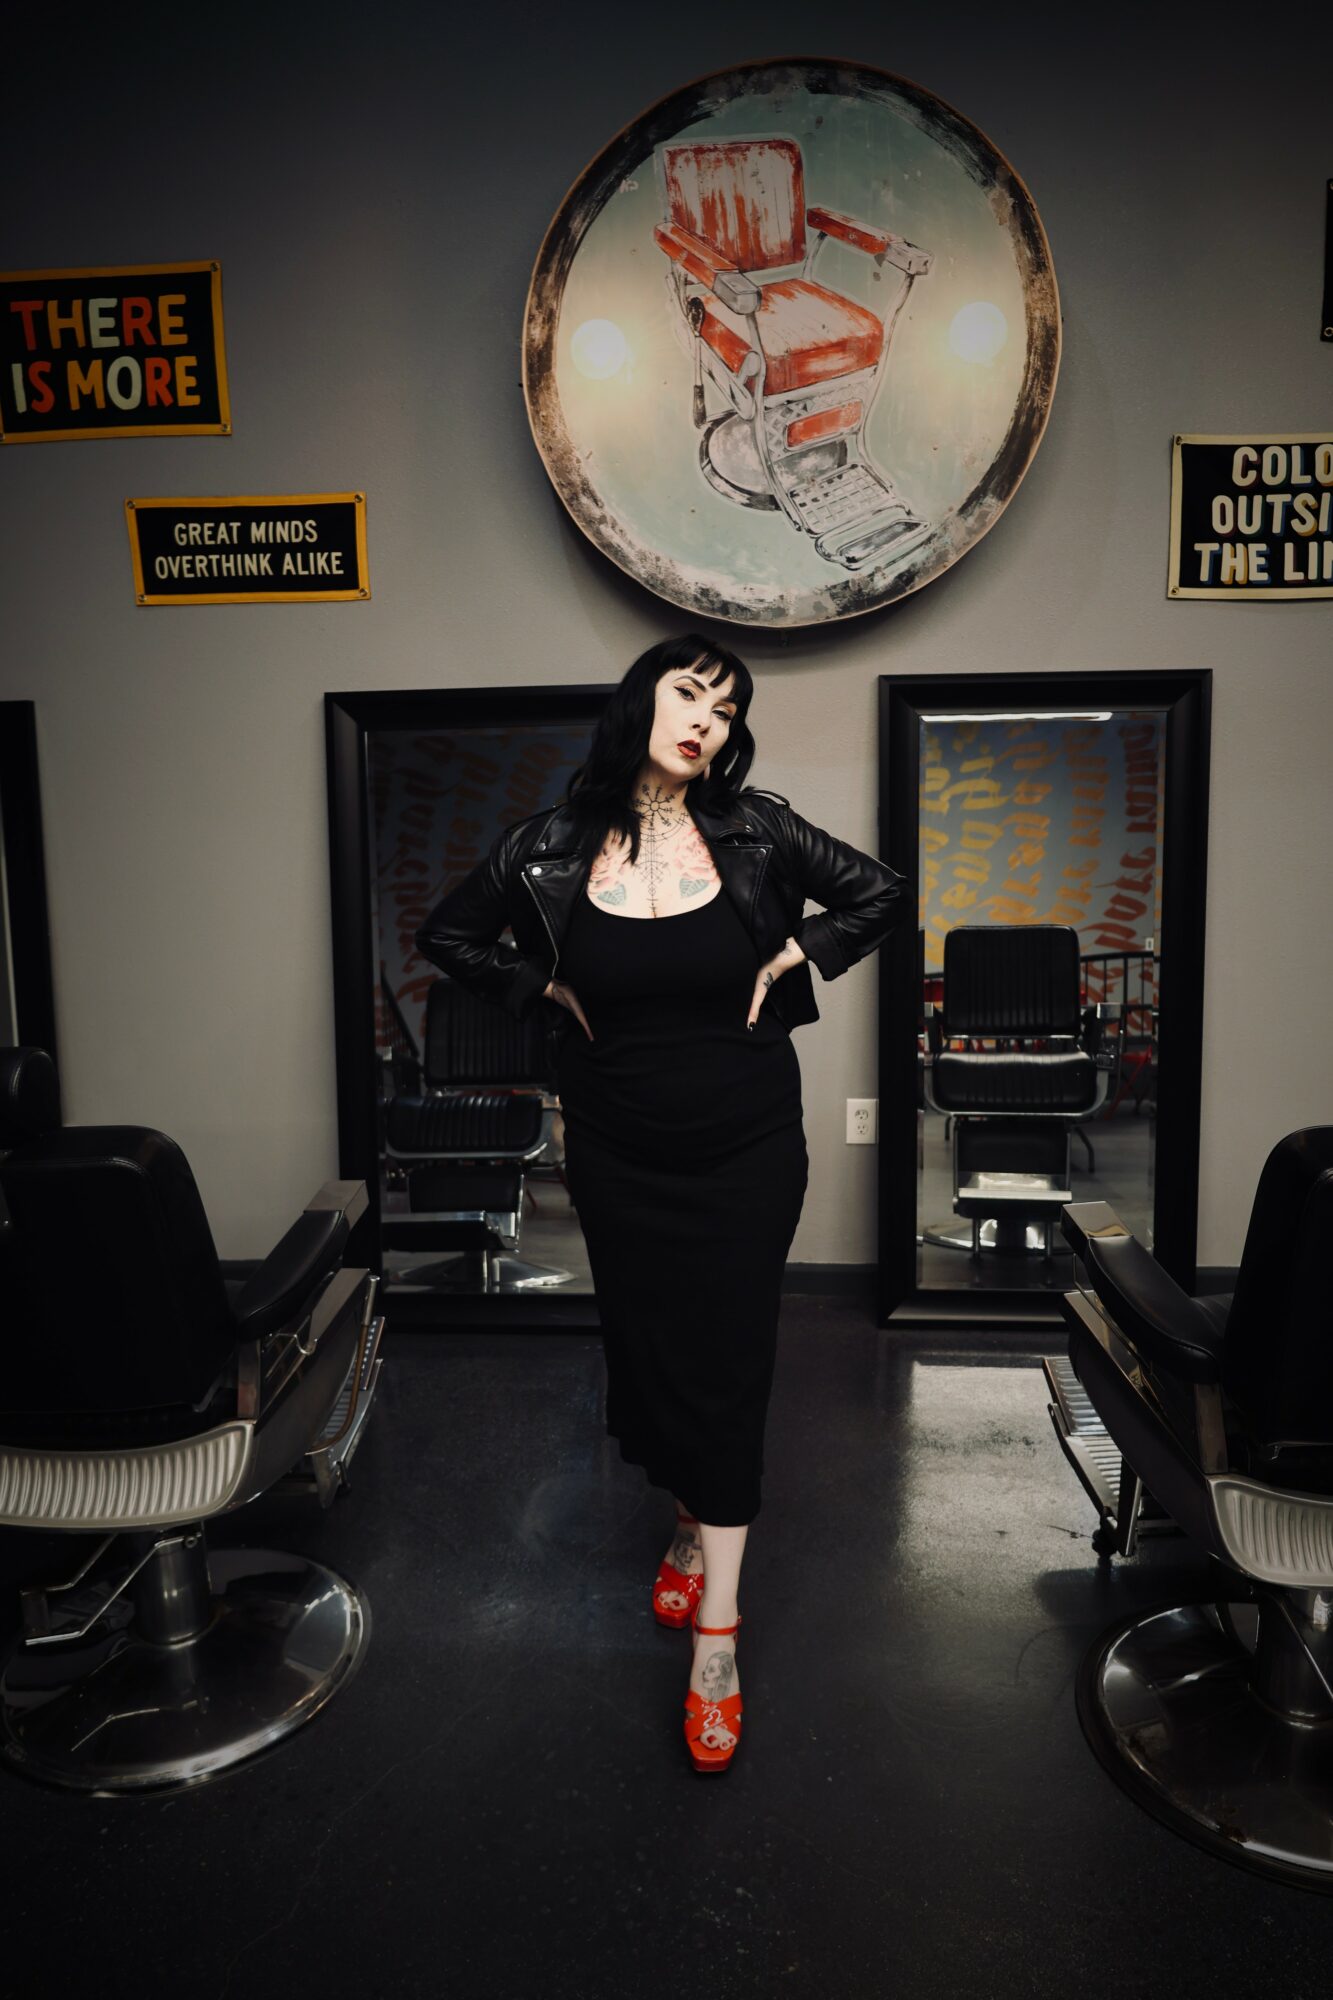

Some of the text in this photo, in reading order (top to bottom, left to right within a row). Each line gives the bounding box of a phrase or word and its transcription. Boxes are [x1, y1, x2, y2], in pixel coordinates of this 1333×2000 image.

[10, 294, 188, 350] THERE
[12, 356, 200, 413] IS MORE
[174, 519, 318, 546] GREAT MINDS
[155, 551, 344, 579] OVERTHINK ALIKE
[1194, 542, 1271, 585] THE
